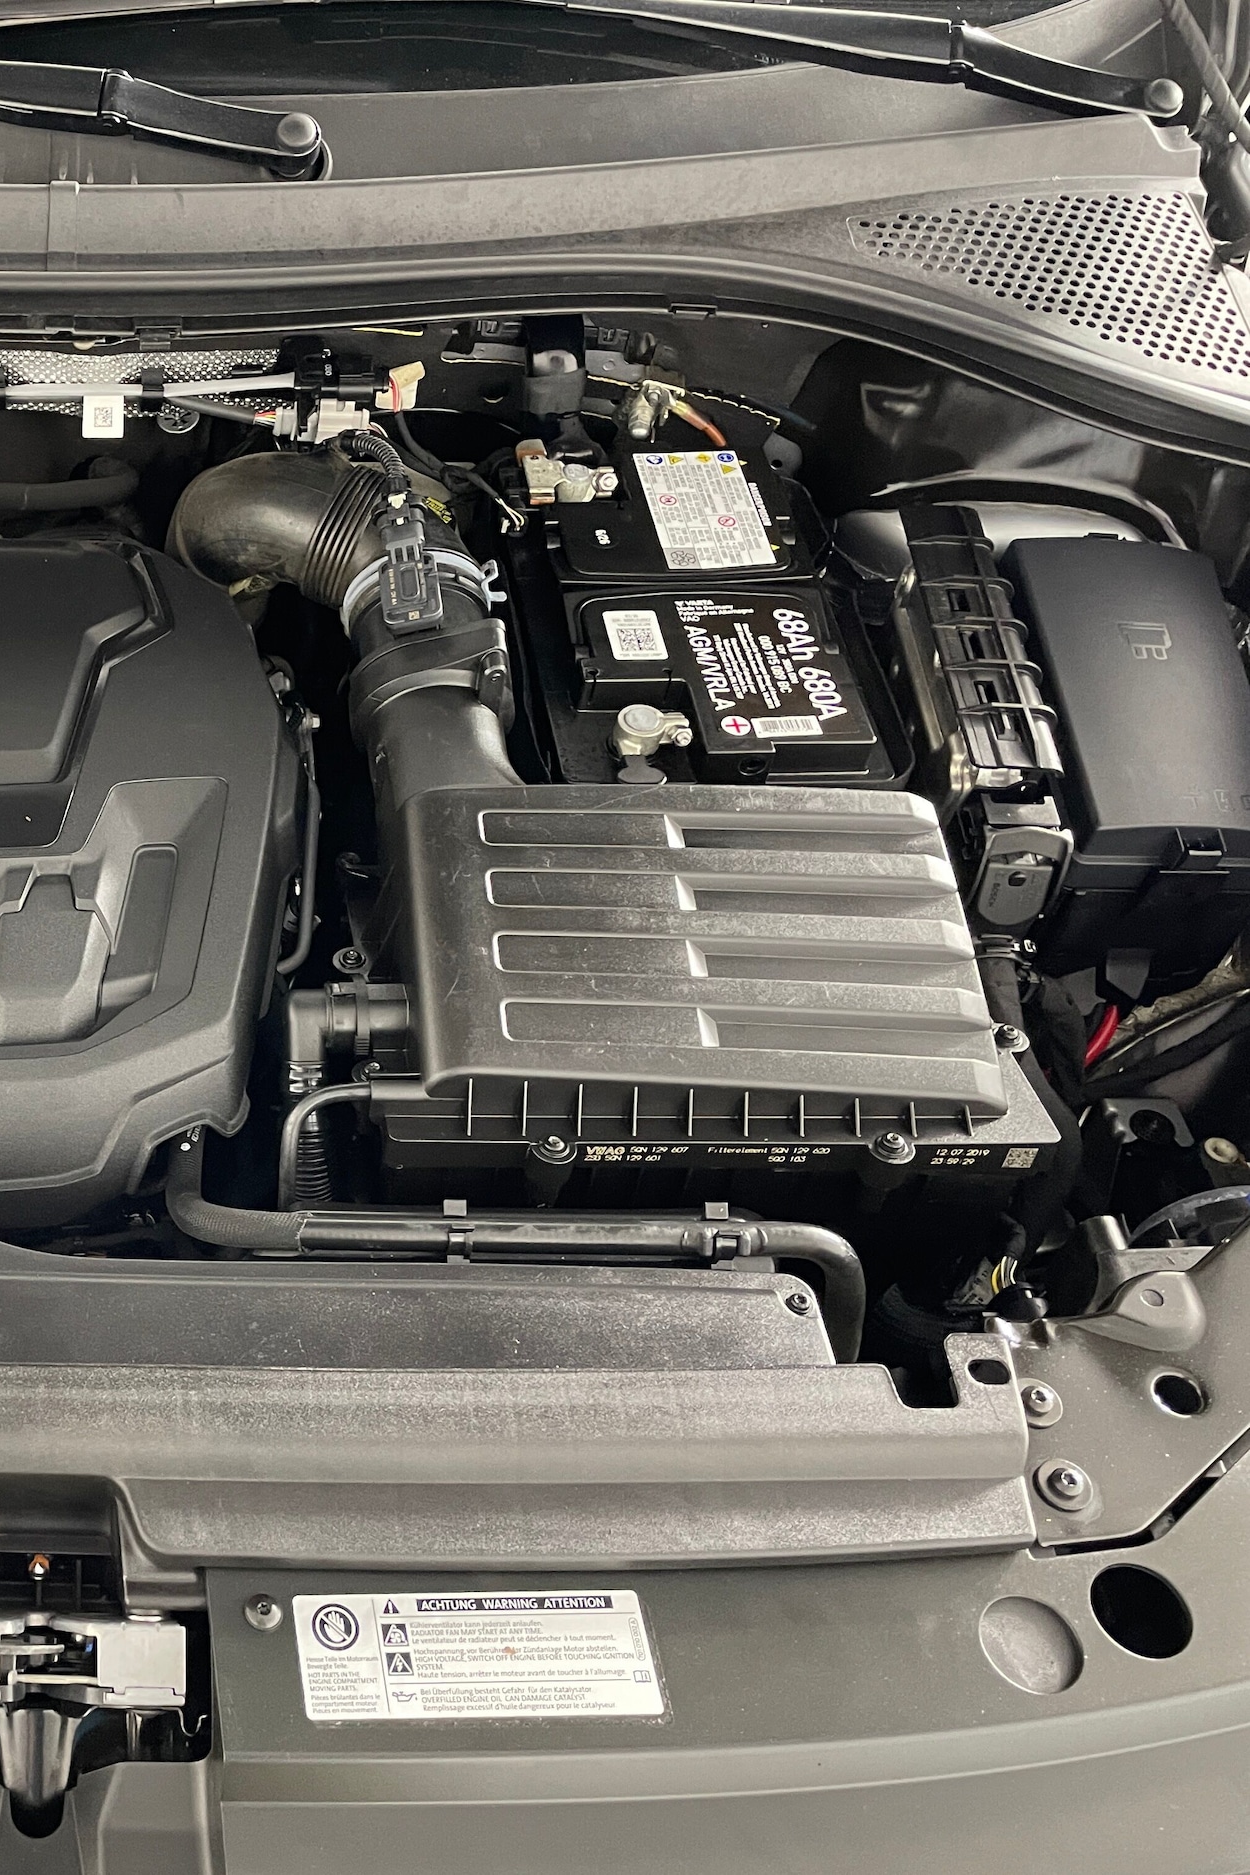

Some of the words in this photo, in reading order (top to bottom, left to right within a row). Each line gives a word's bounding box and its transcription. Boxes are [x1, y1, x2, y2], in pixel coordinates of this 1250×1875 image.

[758, 635, 774, 650] 000
[764, 650, 780, 665] 915
[773, 609, 820, 660] 68Ah
[798, 666, 847, 721] 680A
[684, 625, 736, 711] AGM/VRLA
[777, 681, 792, 693] BC
[671, 1146, 689, 1154] 607
[422, 1599, 477, 1611] ACHTUNG
[482, 1598, 538, 1610] WARNING
[543, 1597, 606, 1608] ATTENTION
